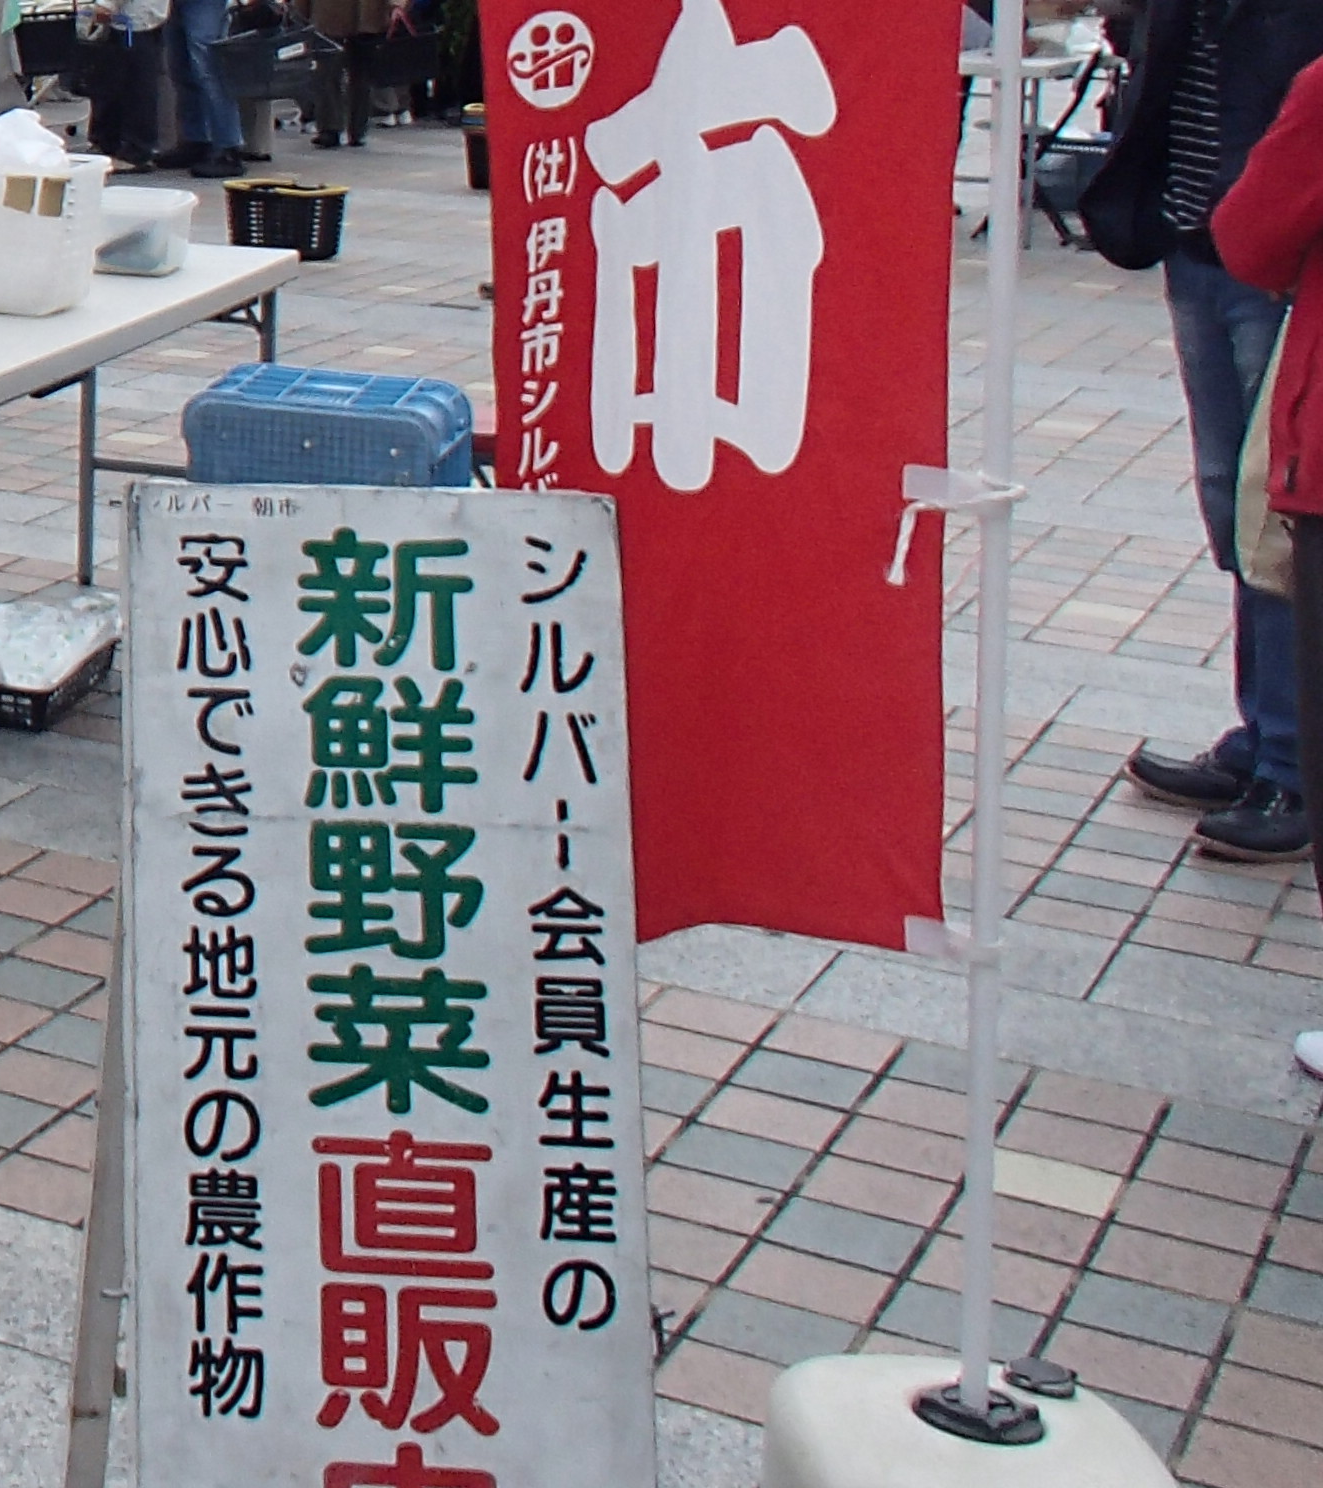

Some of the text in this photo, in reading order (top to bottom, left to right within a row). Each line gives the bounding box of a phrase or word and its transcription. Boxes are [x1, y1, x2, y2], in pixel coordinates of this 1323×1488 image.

[151, 494, 234, 512] ルバー
[176, 533, 264, 1419] 安心できる地元の農作物
[519, 536, 618, 1332] シルバー会員生産の
